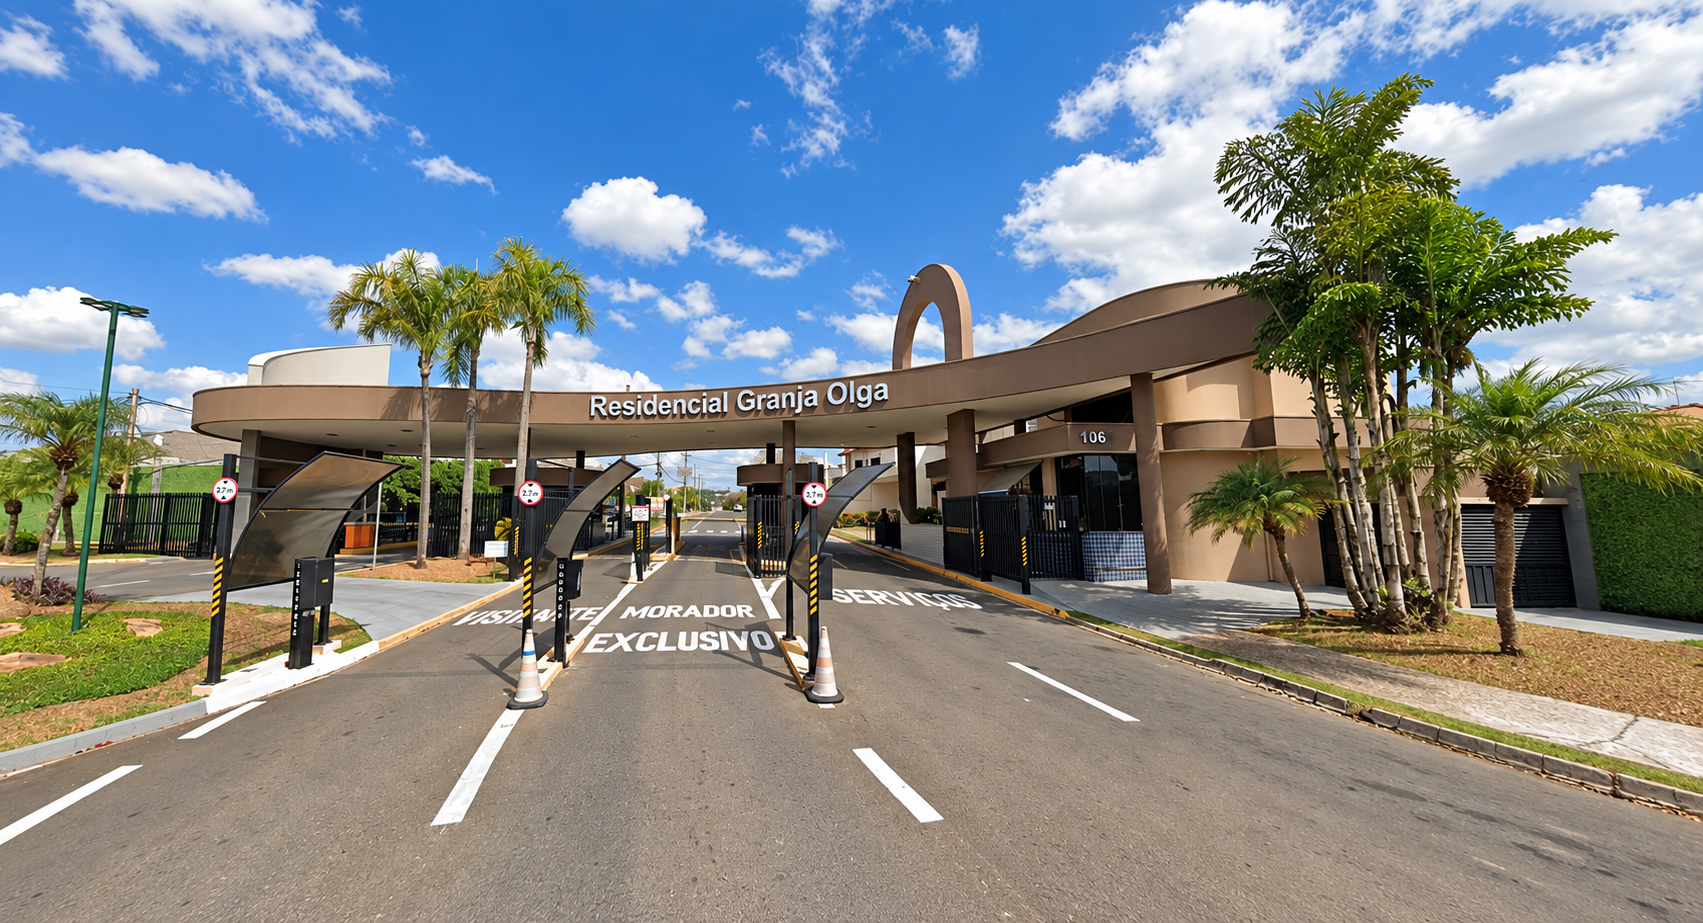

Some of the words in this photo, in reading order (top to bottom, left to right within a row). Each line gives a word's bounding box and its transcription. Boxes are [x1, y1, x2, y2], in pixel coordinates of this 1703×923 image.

[589, 391, 728, 417] Residencial
[737, 385, 818, 414] Granja
[826, 380, 889, 409] Olga
[1080, 430, 1107, 444] 106
[619, 604, 756, 619] MORADOR
[582, 630, 775, 653] EXCLUSIVO
